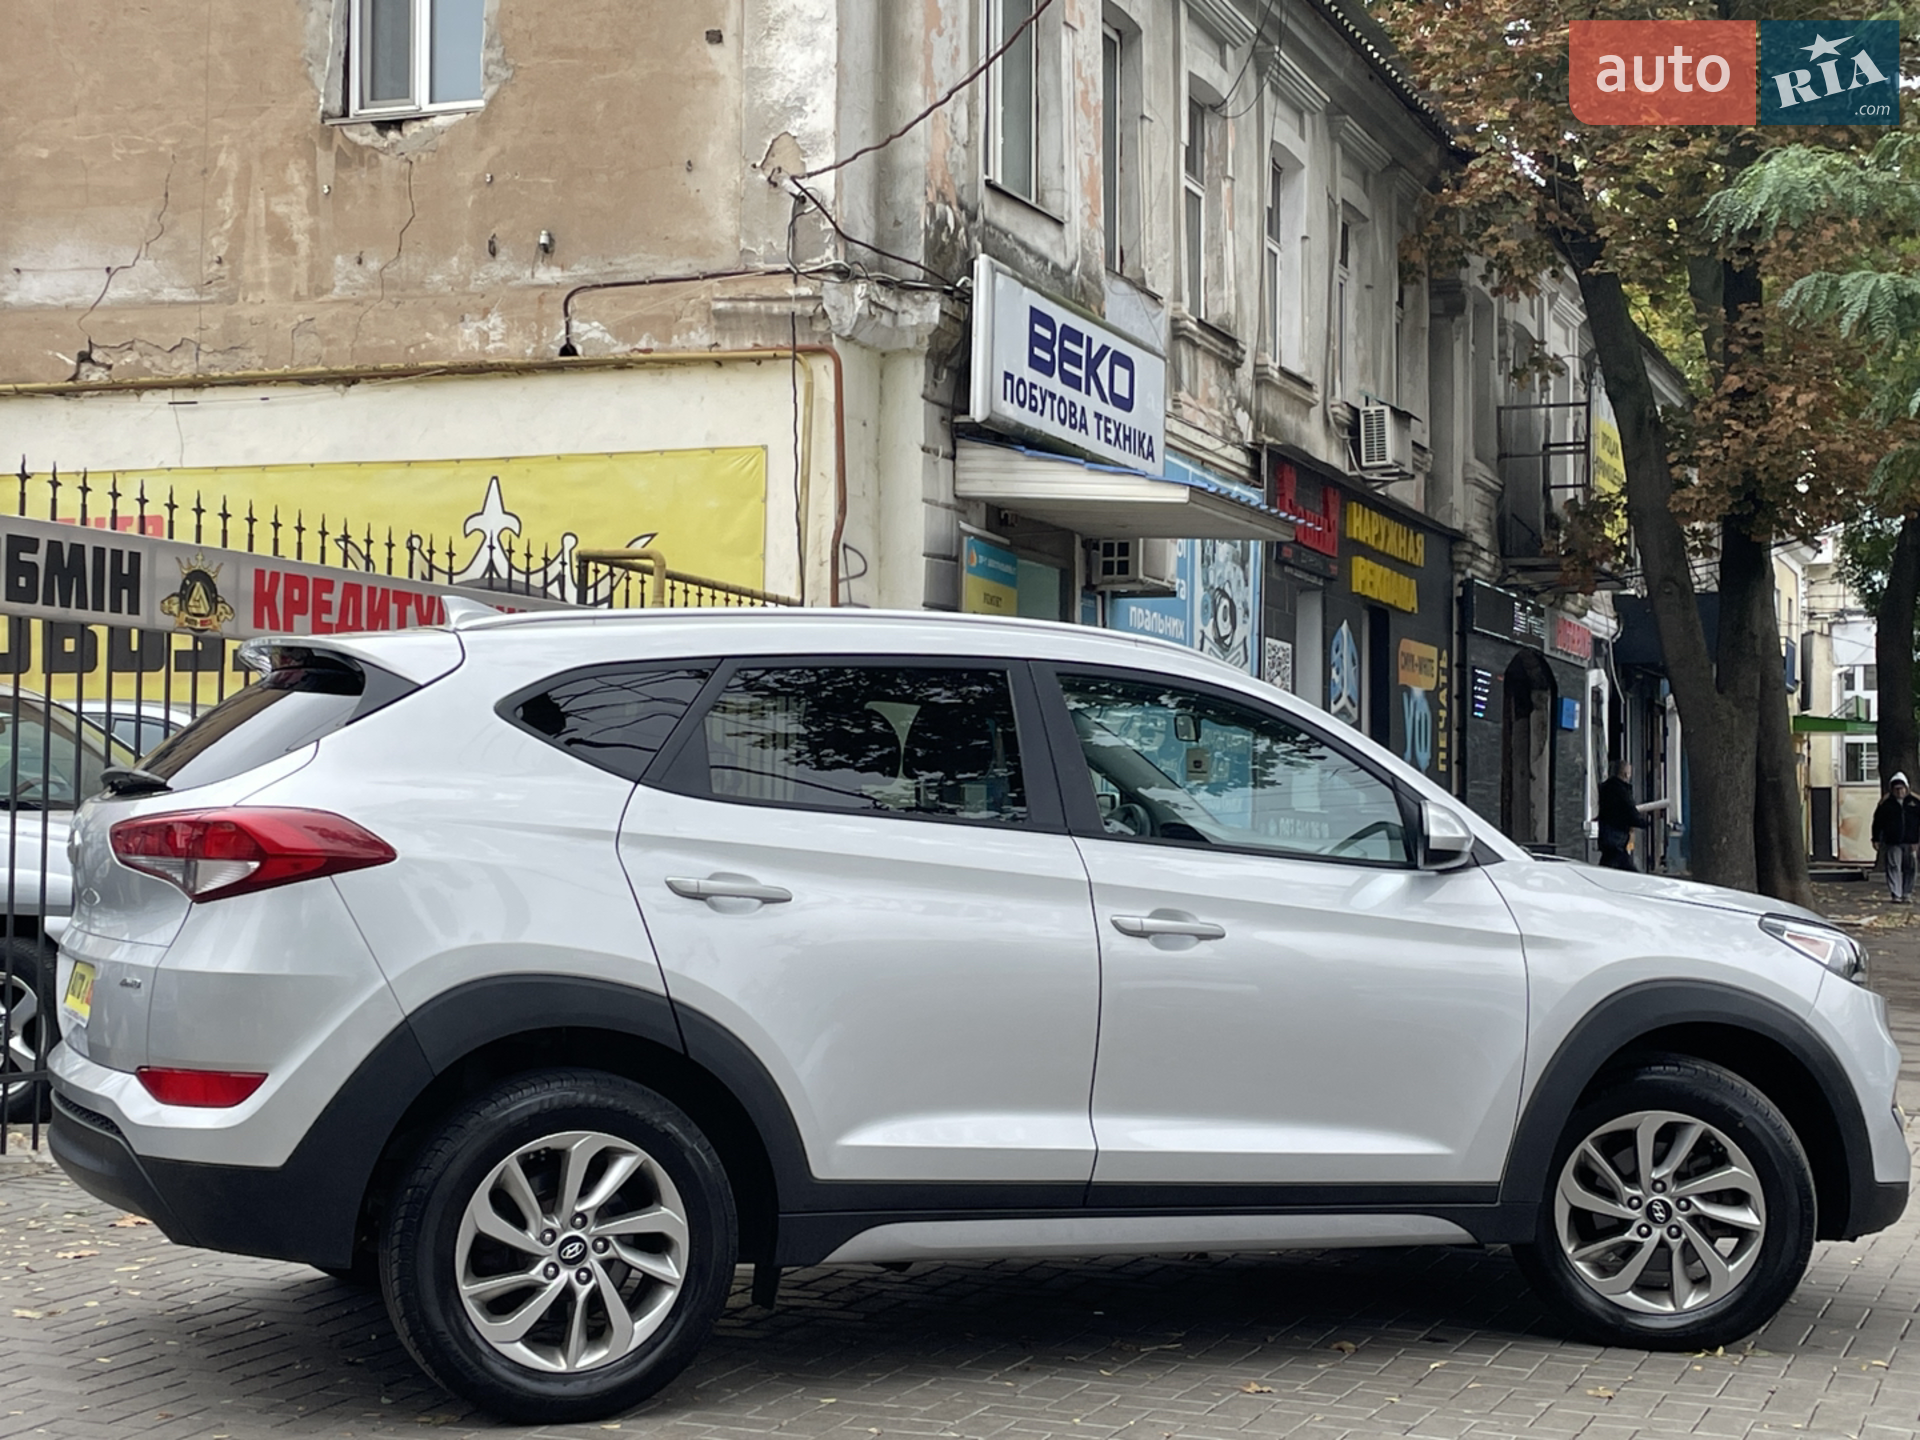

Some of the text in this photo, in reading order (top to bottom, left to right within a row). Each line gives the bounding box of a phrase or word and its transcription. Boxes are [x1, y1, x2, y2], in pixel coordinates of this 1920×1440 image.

[1028, 305, 1135, 413] BEKO
[1003, 370, 1155, 463] ПОБУТОВА ТЕХНІКА
[0, 533, 142, 616] БМІН
[1347, 501, 1425, 568] НАРУЖНАЯ
[252, 568, 527, 636] КРЕДИТУ
[1129, 606, 1185, 640] пральних
[1438, 649, 1449, 772] ПЕЧАТЬ
